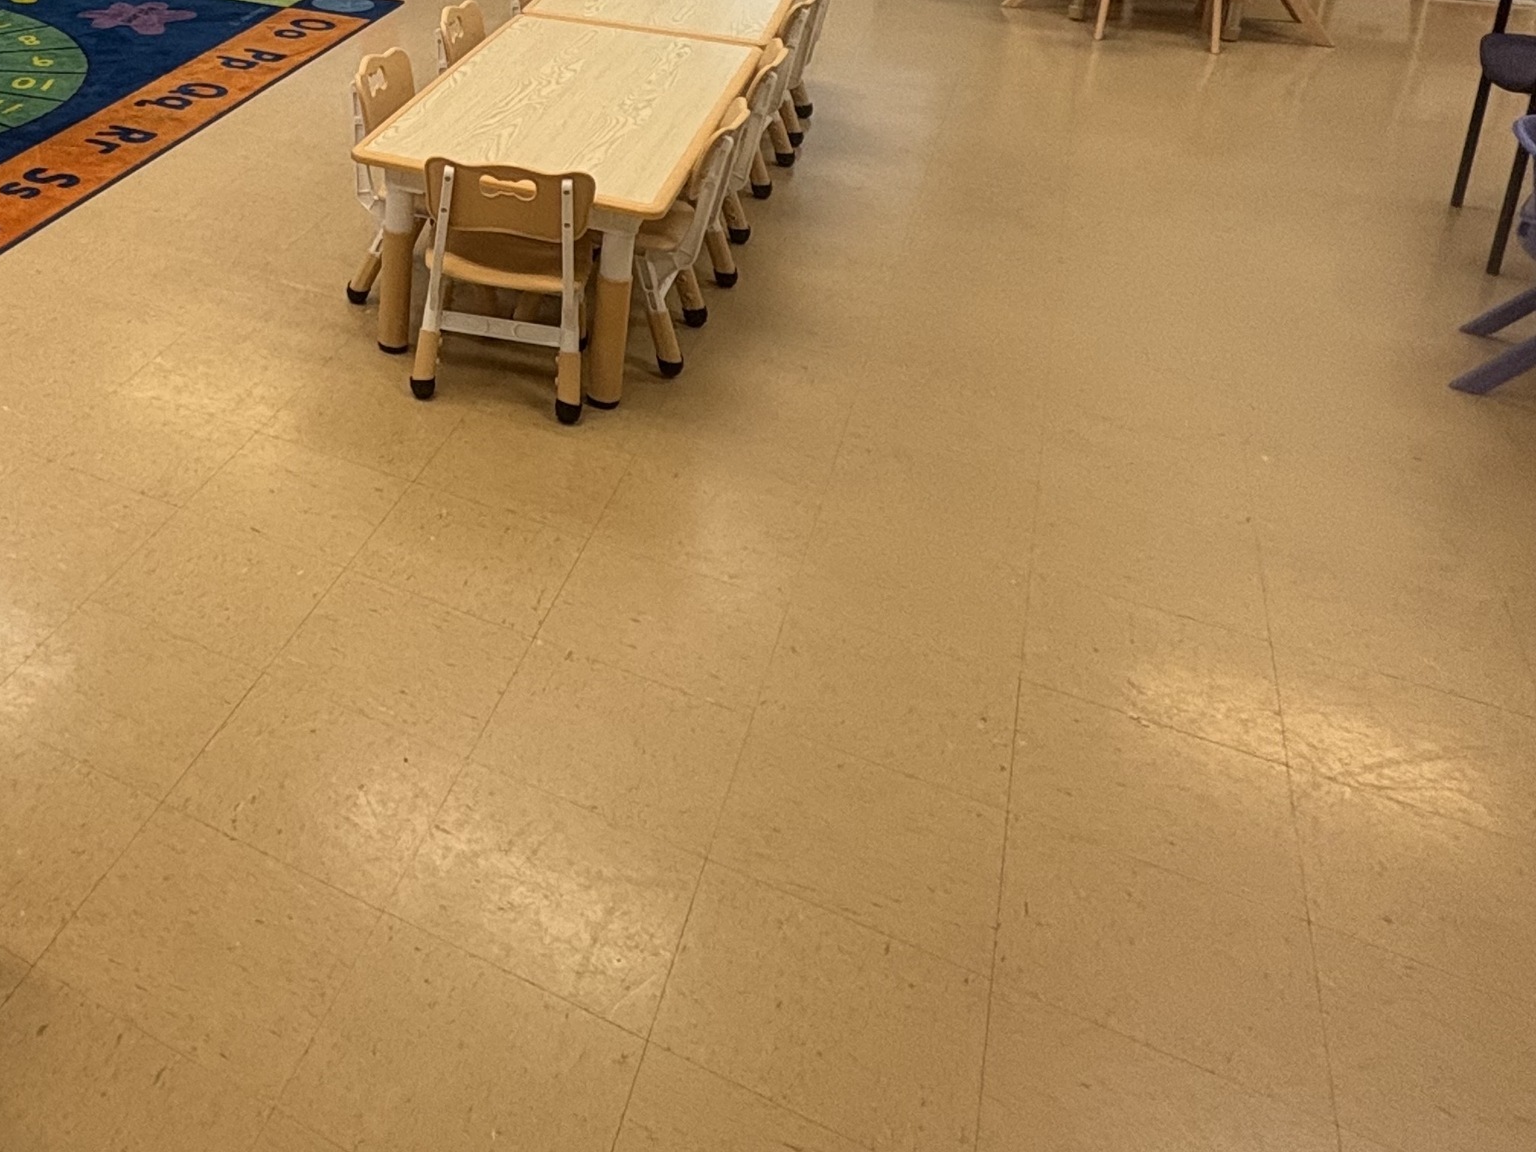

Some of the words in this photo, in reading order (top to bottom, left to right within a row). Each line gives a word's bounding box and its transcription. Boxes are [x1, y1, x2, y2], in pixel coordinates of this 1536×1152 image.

[16, 33, 42, 46] 8
[272, 17, 337, 40] Oo
[31, 54, 56, 68] 9
[216, 47, 289, 71] Pp
[11, 76, 56, 92] 10
[133, 81, 229, 111] Qq
[84, 123, 159, 155] Rr
